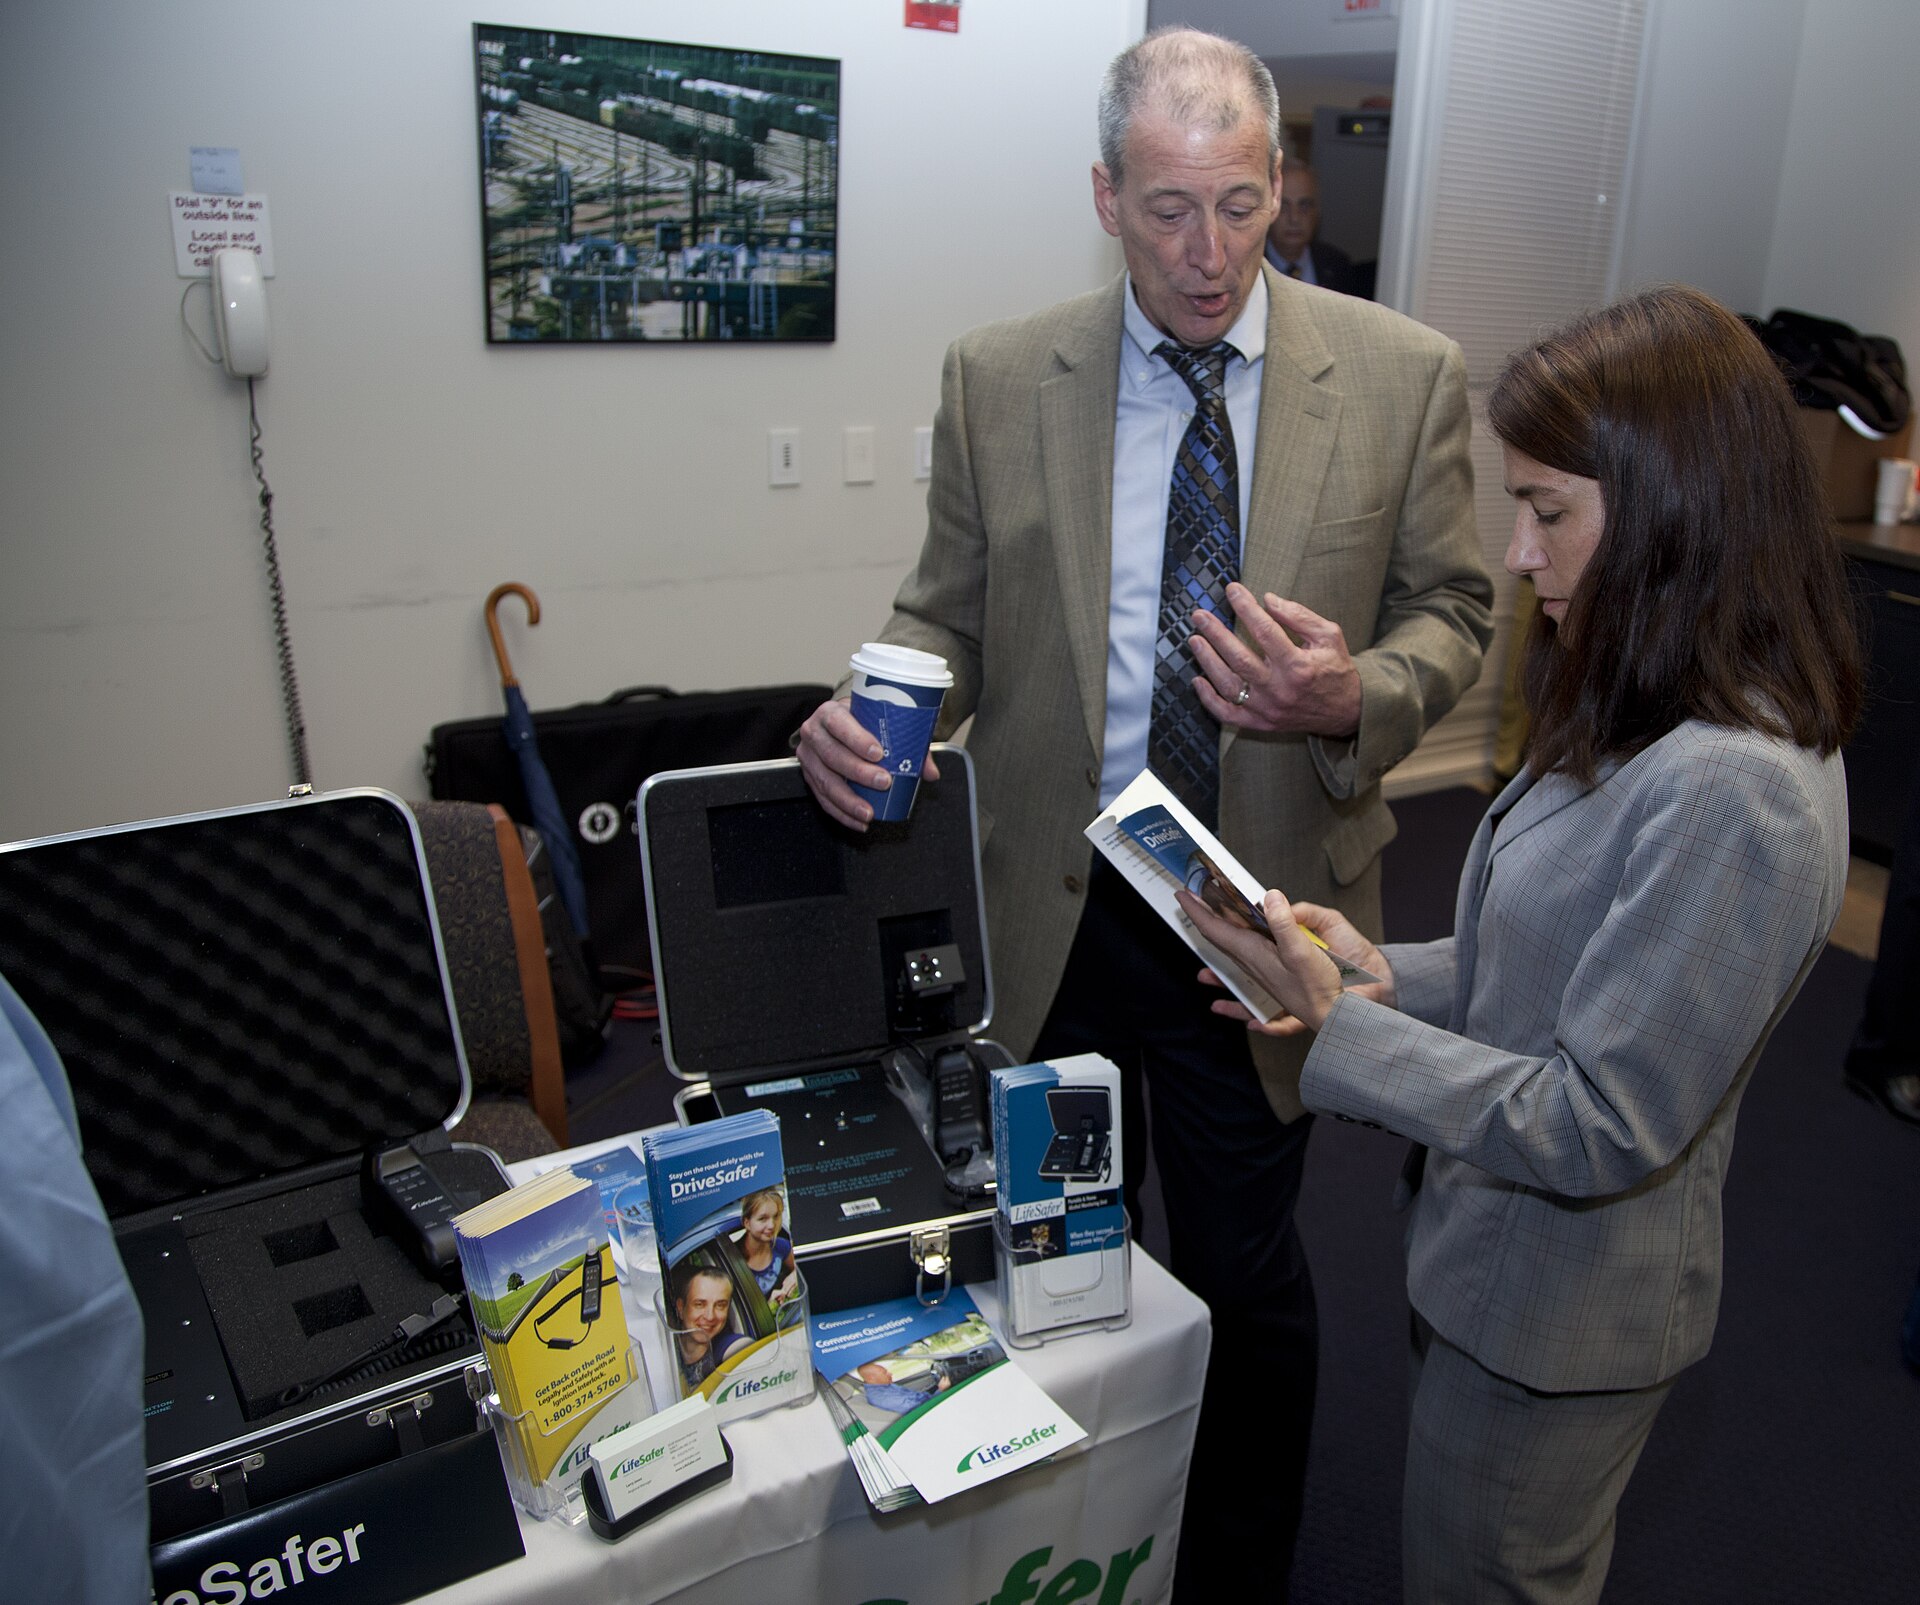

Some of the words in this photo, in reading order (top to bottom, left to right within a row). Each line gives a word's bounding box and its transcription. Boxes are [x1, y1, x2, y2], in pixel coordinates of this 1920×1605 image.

[175, 196, 200, 208] Dial
[226, 197, 243, 209] for
[247, 201, 263, 209] an
[182, 211, 229, 220] outside
[191, 230, 227, 241] Local
[231, 230, 255, 242] and
[668, 1173, 683, 1182] Stay
[683, 1170, 693, 1178] on
[693, 1166, 704, 1175] the
[704, 1160, 720, 1172] road
[720, 1156, 738, 1168] safely
[739, 1153, 753, 1164] with
[753, 1151, 765, 1160] the
[670, 1163, 758, 1198] DriveSafer
[671, 1193, 697, 1206] EXTENSION
[697, 1187, 720, 1198] PROGRAM
[1015, 1201, 1063, 1221] LifeSafer
[815, 1331, 863, 1348] Common
[862, 1316, 914, 1337] Questions
[535, 1386, 550, 1399] Get
[550, 1372, 570, 1389] Back
[570, 1367, 581, 1378] on
[581, 1358, 595, 1371] the
[595, 1344, 616, 1362] Road
[538, 1389, 561, 1407] Legally
[561, 1381, 574, 1393] and
[574, 1367, 594, 1386] Safely
[594, 1360, 608, 1373] with
[608, 1356, 617, 1365] an
[735, 1369, 798, 1399] LifeSafer
[543, 1373, 621, 1427] 1-800-374-5760
[552, 1388, 578, 1408] Ignition
[577, 1371, 606, 1392] Interlock.
[144, 1405, 171, 1417] NGINE
[977, 1423, 1058, 1465] LifeSafer
[622, 1446, 665, 1475] LifeSafer
[151, 1523, 365, 1605] Safer
